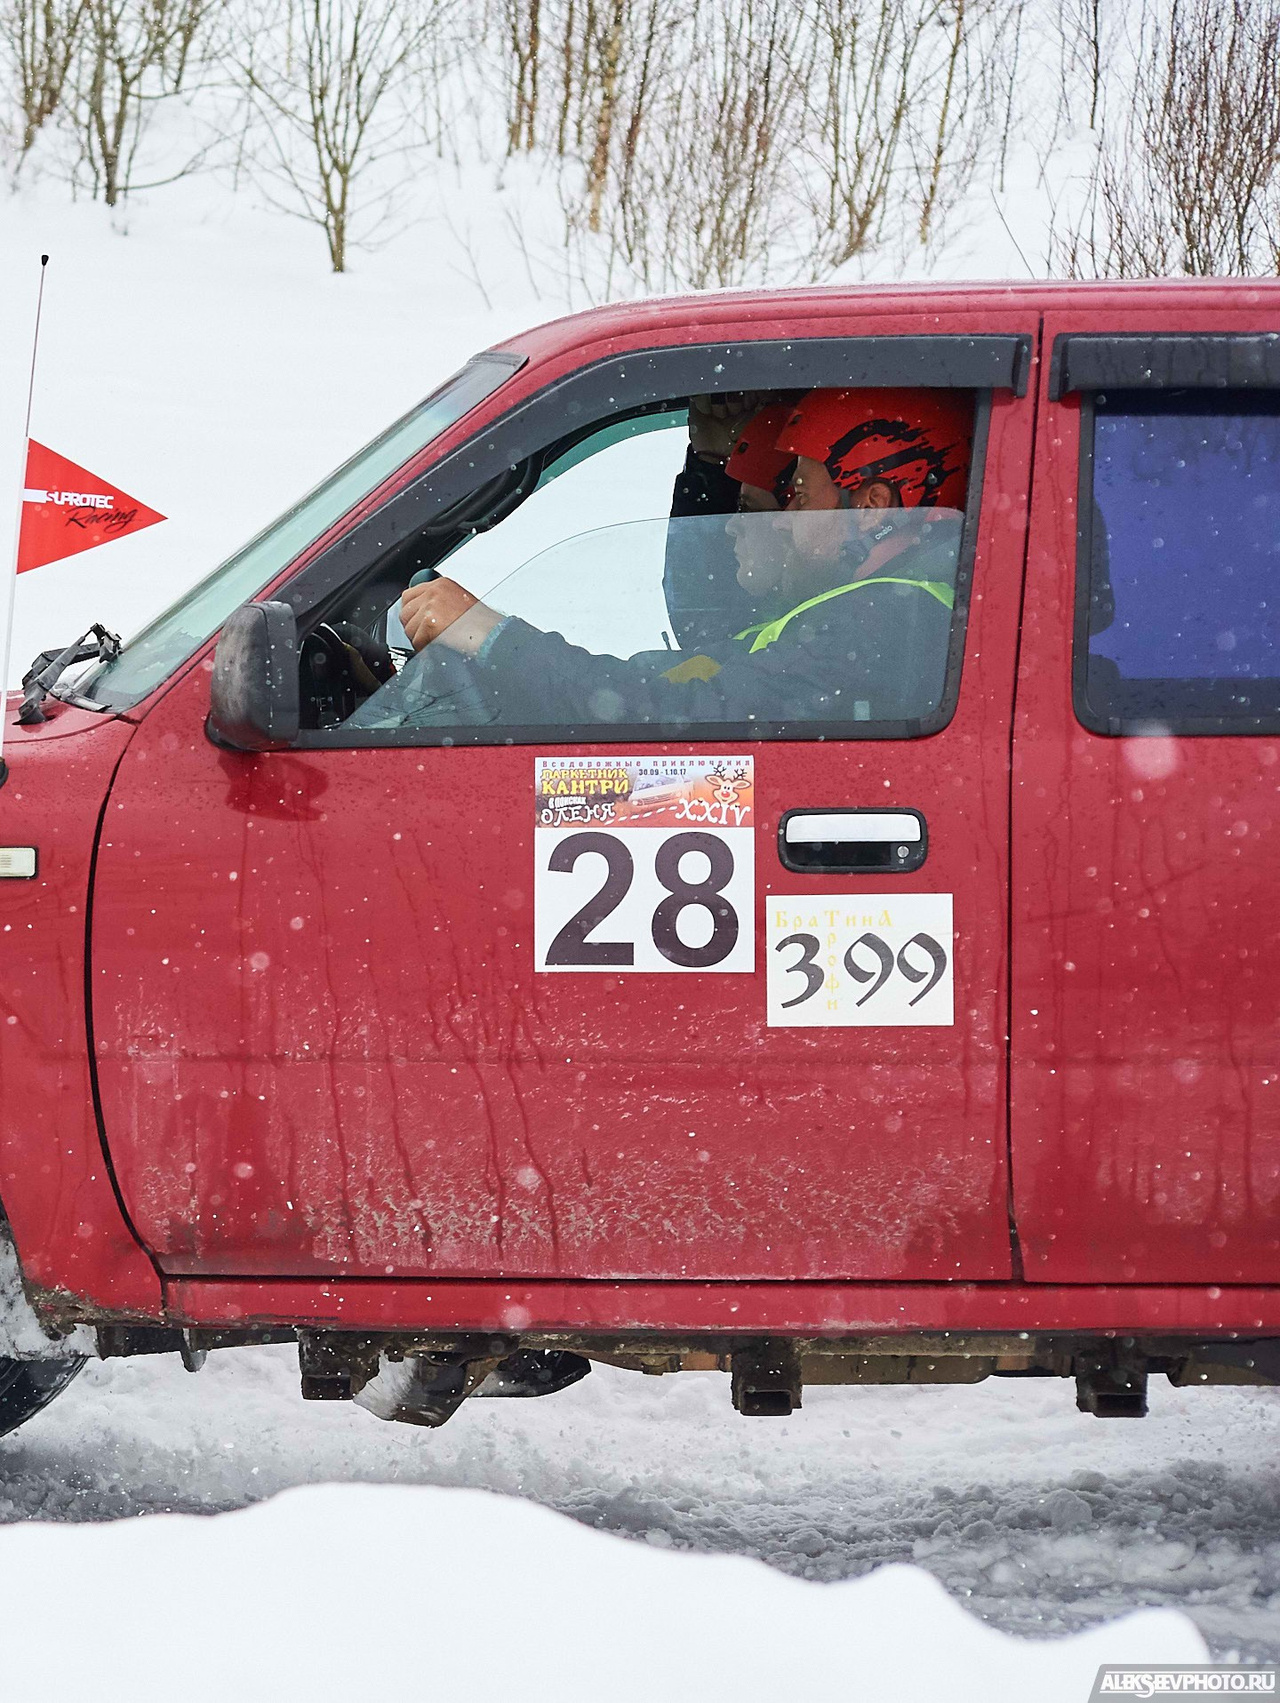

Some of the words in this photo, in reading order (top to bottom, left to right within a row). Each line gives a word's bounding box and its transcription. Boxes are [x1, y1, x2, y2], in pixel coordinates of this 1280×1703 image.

[46, 491, 115, 509] SUPROTEC
[65, 505, 138, 533] Racing
[540, 768, 629, 779] ПАРКЕТНИК
[542, 760, 641, 768] Вседорожные
[638, 768, 660, 776] 30.09
[540, 779, 630, 795] КАНТРИ
[540, 802, 617, 827] ОЛЕНЯ
[675, 797, 751, 826] XXIV
[545, 832, 739, 968] 28
[775, 932, 947, 1008] 399
